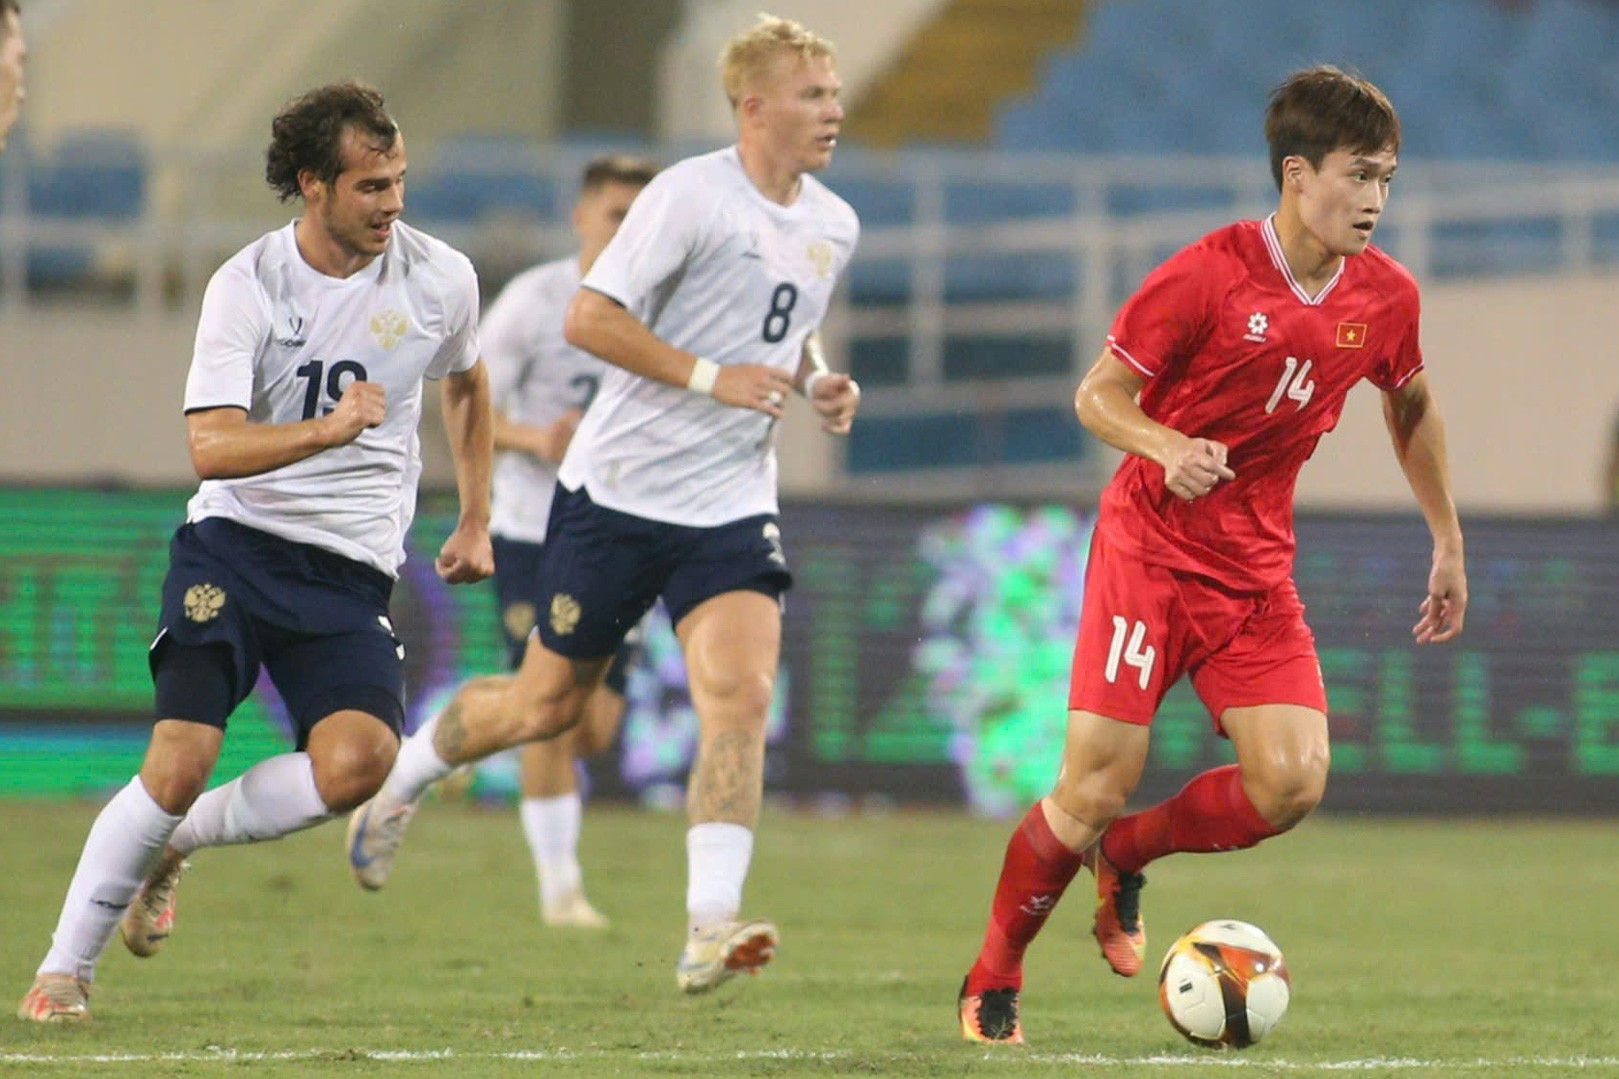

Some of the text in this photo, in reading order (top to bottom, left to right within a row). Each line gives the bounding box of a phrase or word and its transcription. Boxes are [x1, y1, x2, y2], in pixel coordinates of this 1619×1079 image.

[762, 281, 798, 343] 8
[296, 359, 368, 422] 19
[1264, 356, 1315, 414] 14
[1105, 615, 1155, 690] 14
